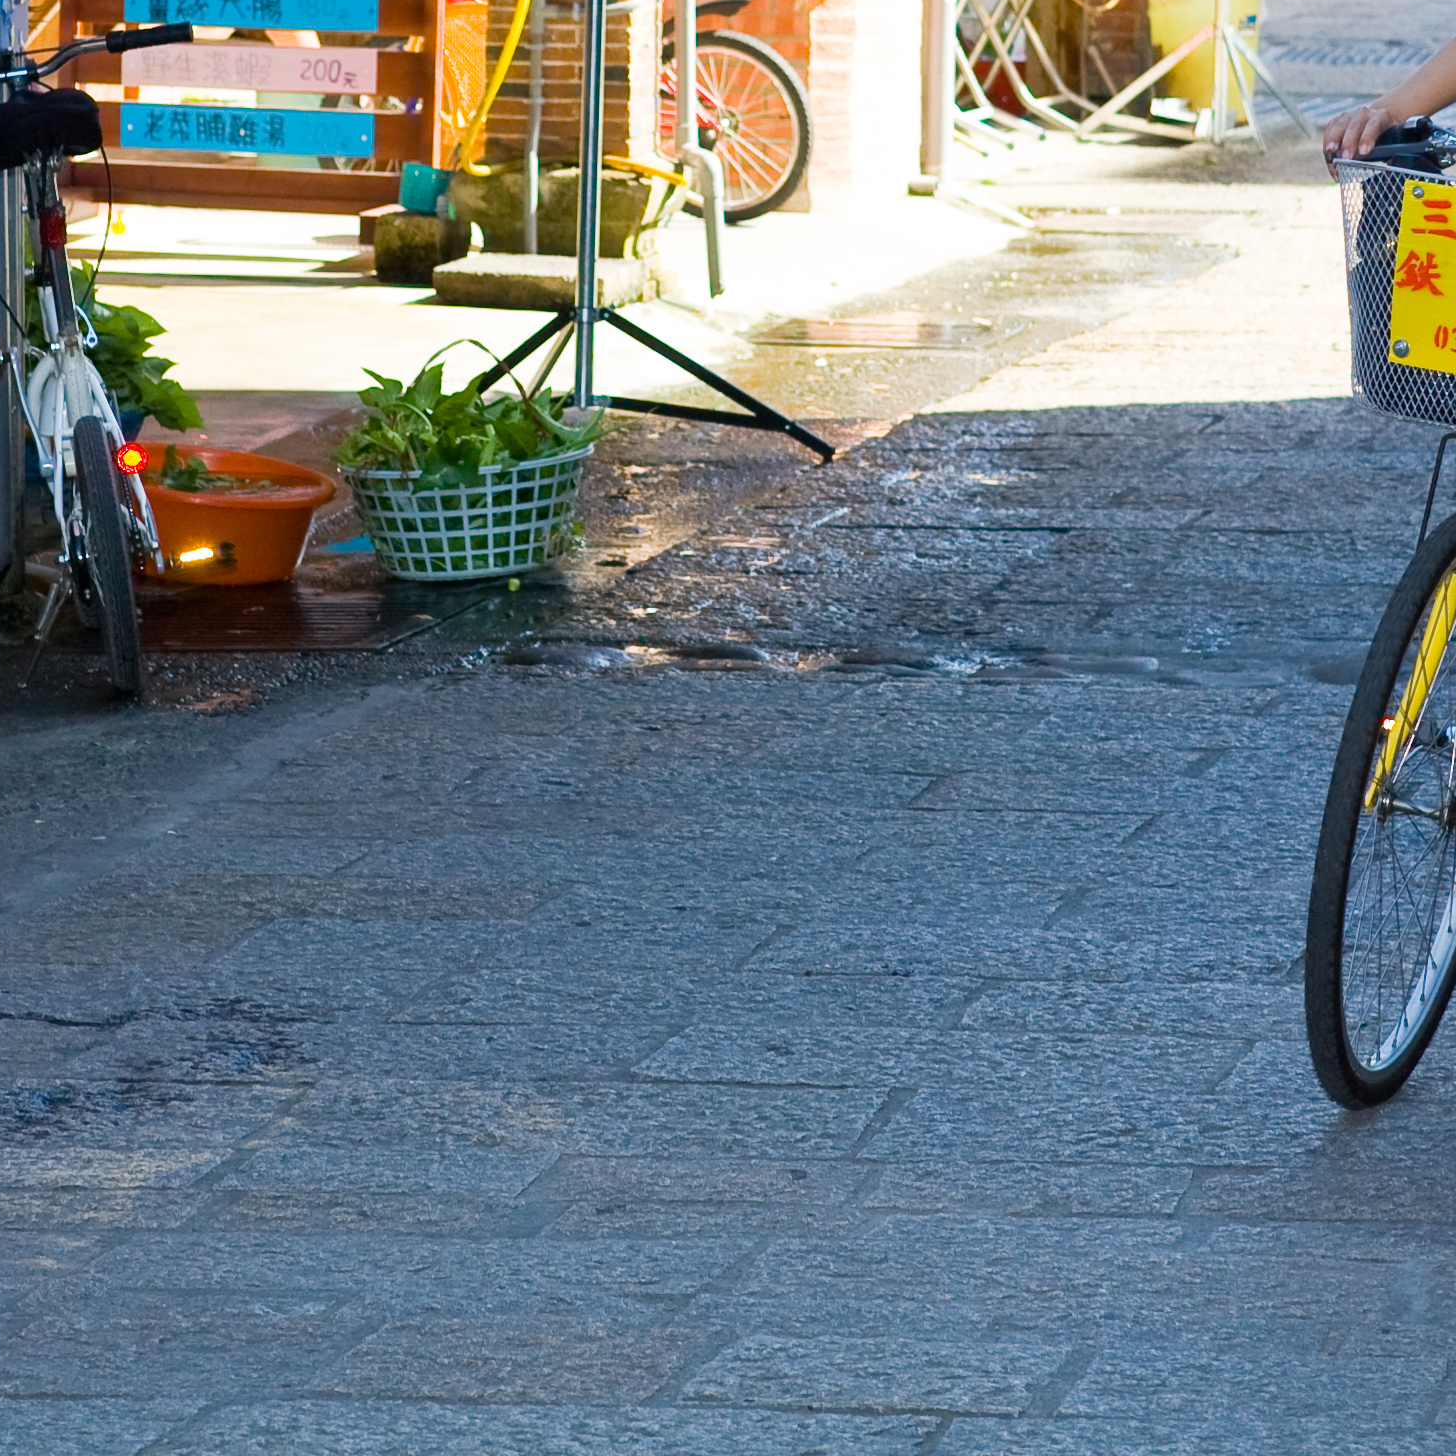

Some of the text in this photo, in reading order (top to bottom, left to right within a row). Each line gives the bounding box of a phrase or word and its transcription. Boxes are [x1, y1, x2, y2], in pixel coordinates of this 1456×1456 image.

[300, 58, 359, 89] 200元
[144, 110, 285, 148] 老菜脯雞湯
